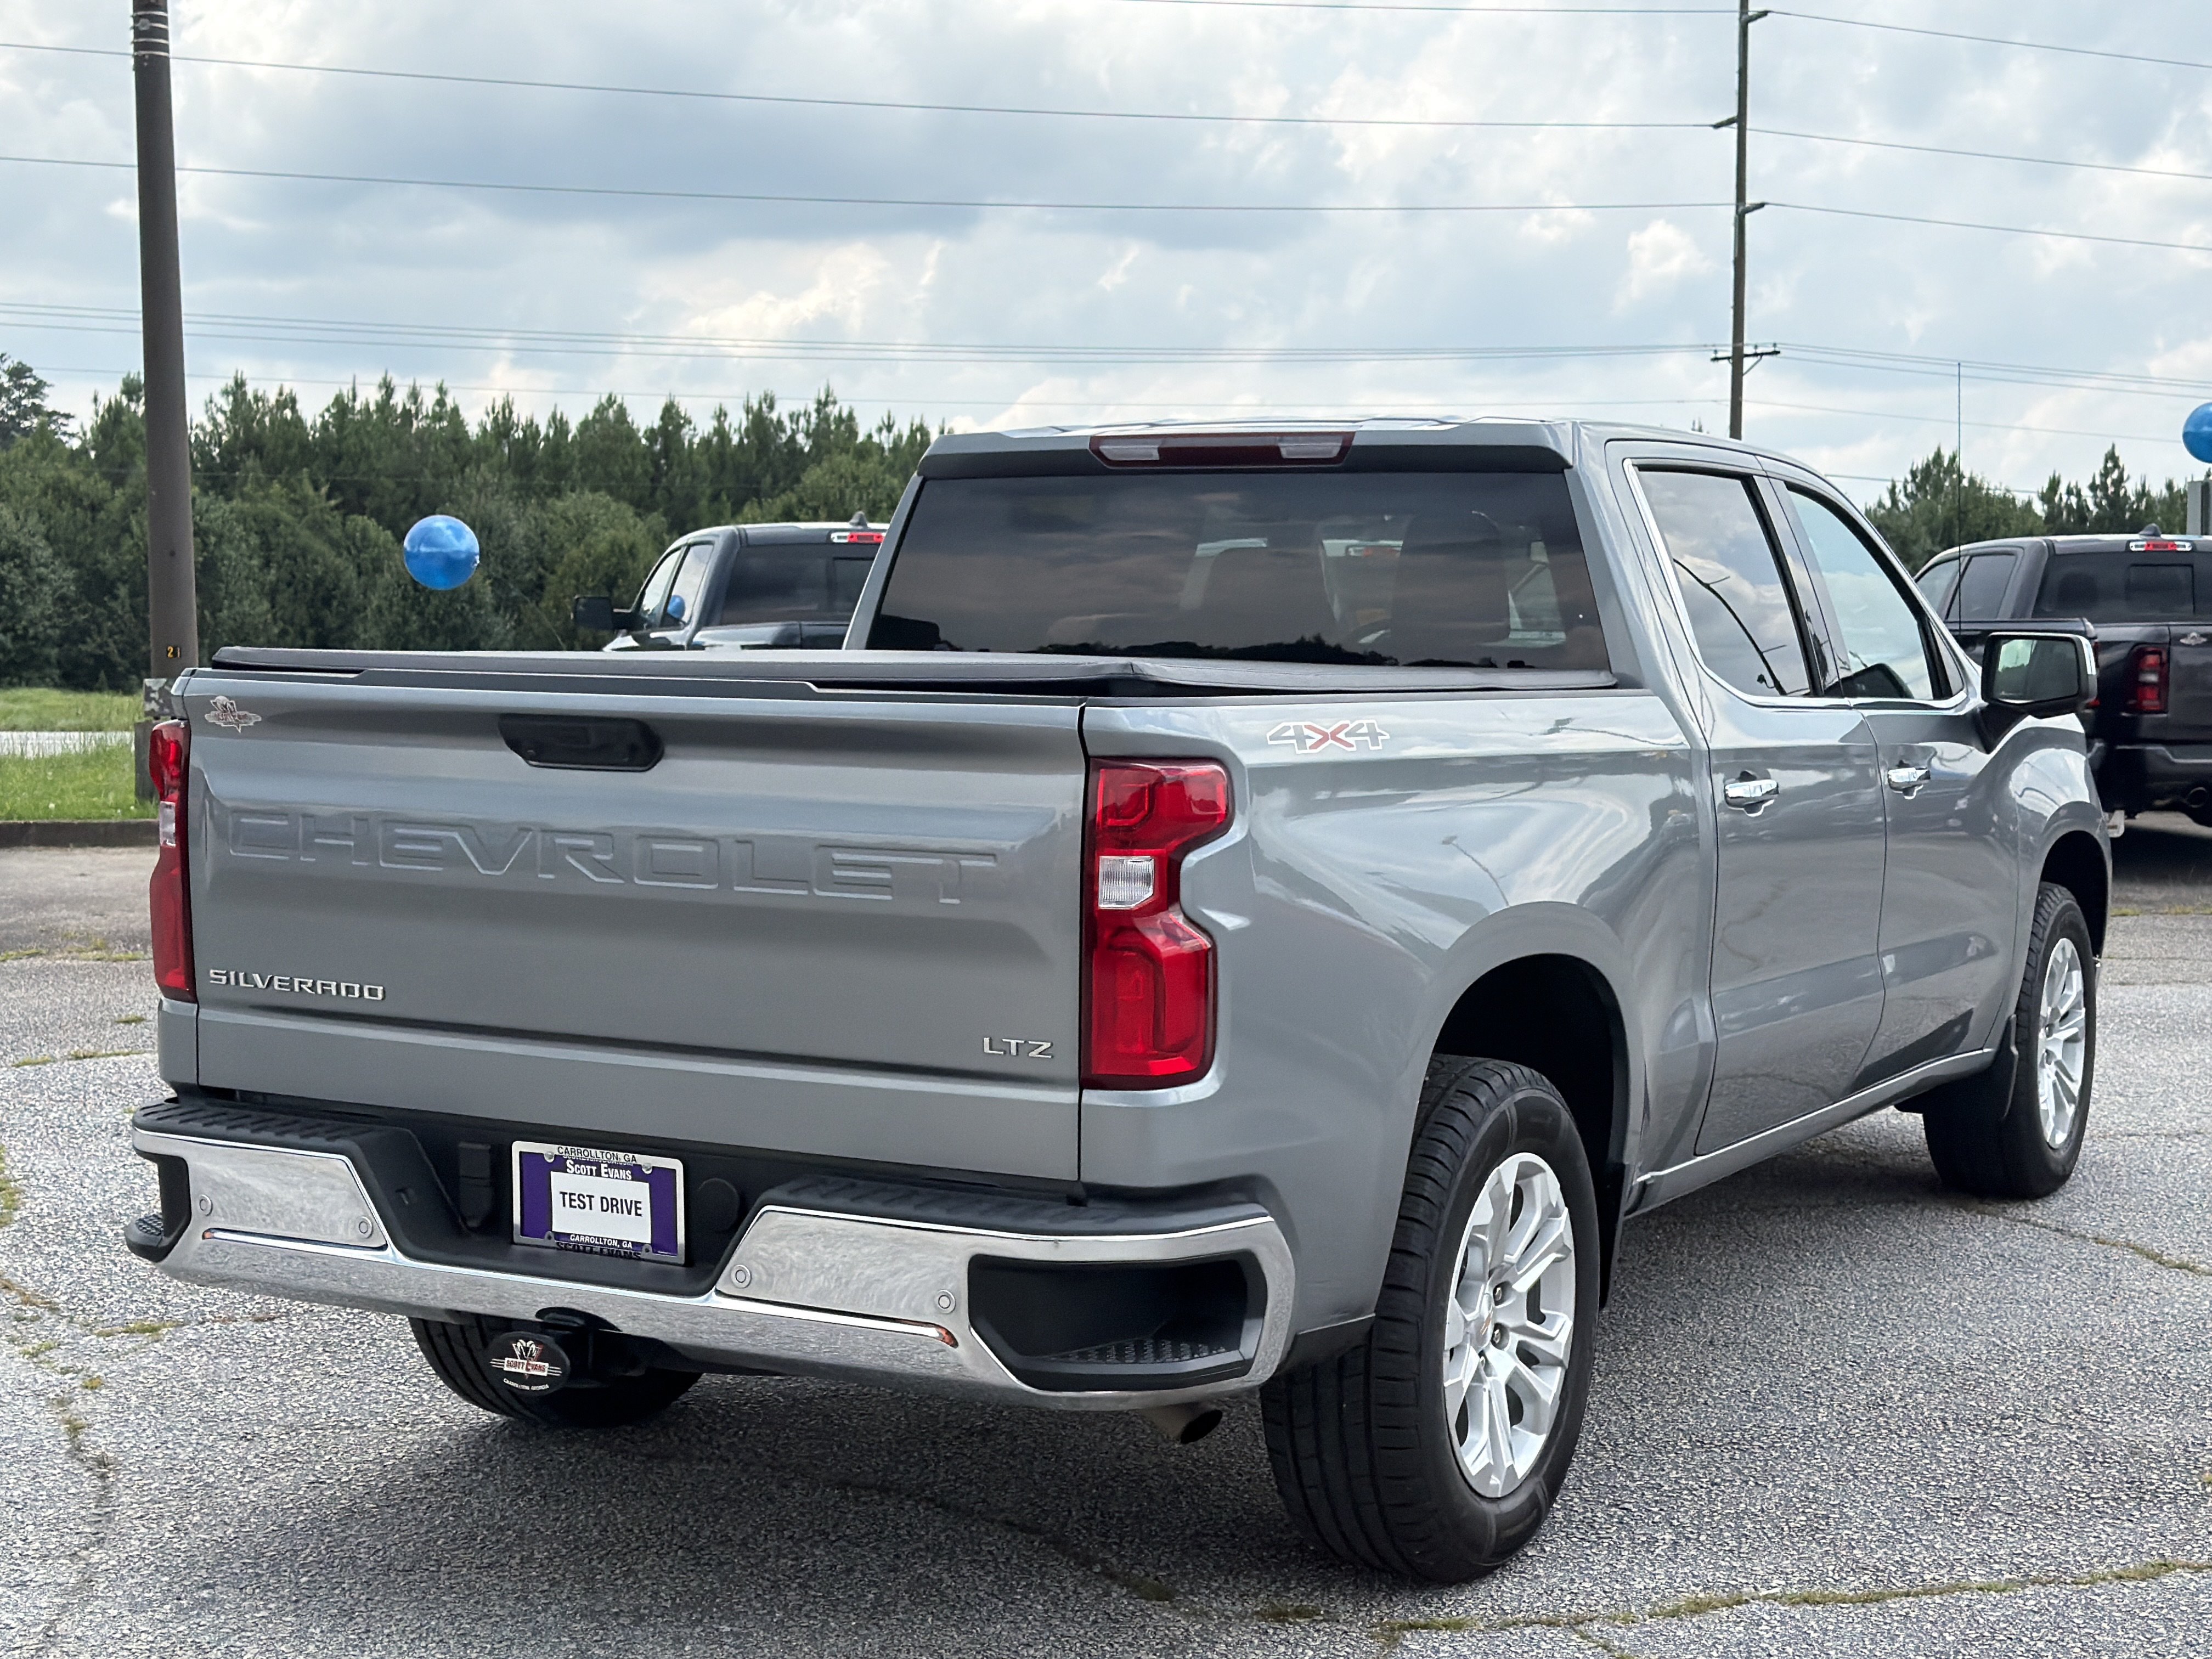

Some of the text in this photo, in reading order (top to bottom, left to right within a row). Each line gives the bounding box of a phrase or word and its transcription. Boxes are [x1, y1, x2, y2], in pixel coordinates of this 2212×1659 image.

[228, 809, 997, 905] CHEVROLET
[209, 969, 385, 1001] SILVERADO
[983, 1036, 1053, 1059] LTZ
[557, 1146, 621, 1161] CARROLLTON,
[623, 1154, 637, 1163] GA
[560, 1191, 643, 1217] TEST DRIVE
[570, 1234, 620, 1248] CARROLLTON,
